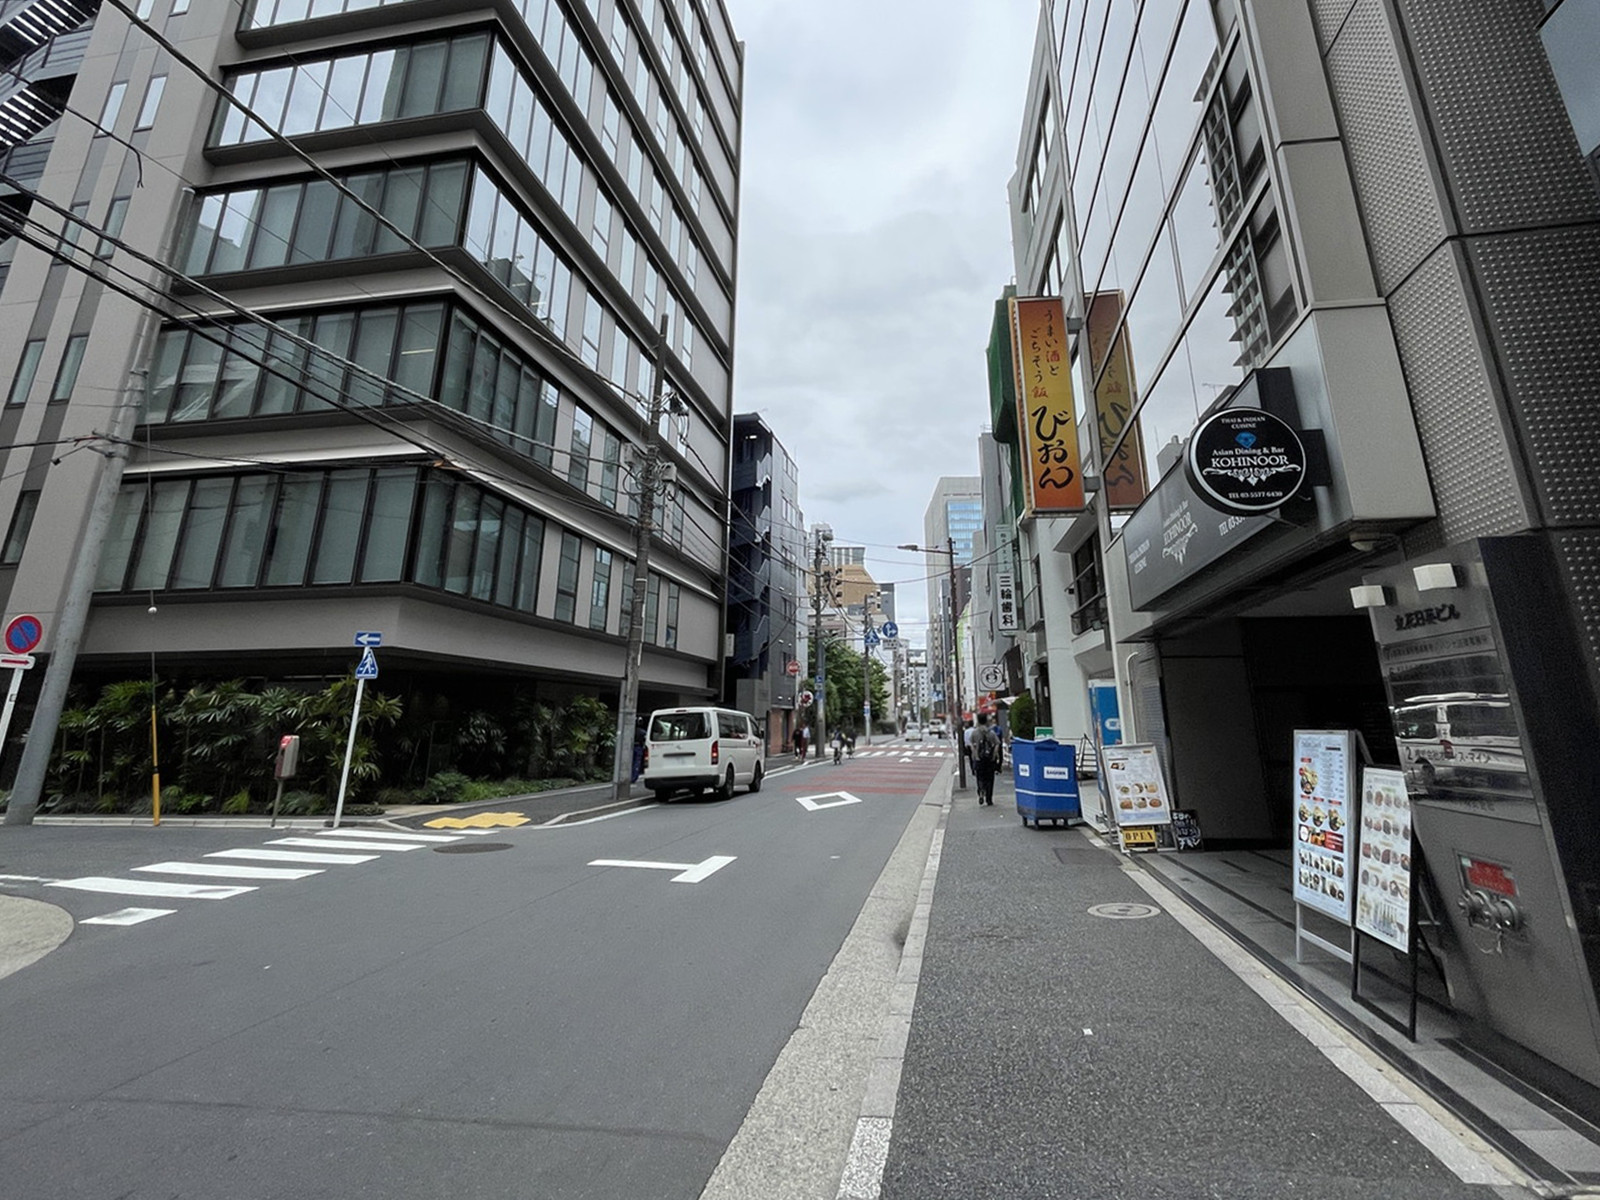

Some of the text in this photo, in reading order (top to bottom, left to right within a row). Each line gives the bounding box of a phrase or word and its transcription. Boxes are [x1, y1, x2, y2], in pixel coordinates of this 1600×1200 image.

[1030, 327, 1049, 398] ごちそう飯
[1044, 309, 1060, 376] うまい酒と
[1031, 405, 1075, 489] びおん
[1211, 455, 1289, 468] KOHINOOR
[1234, 447, 1262, 455] Dining
[1000, 575, 1014, 627] 三輪歯科
